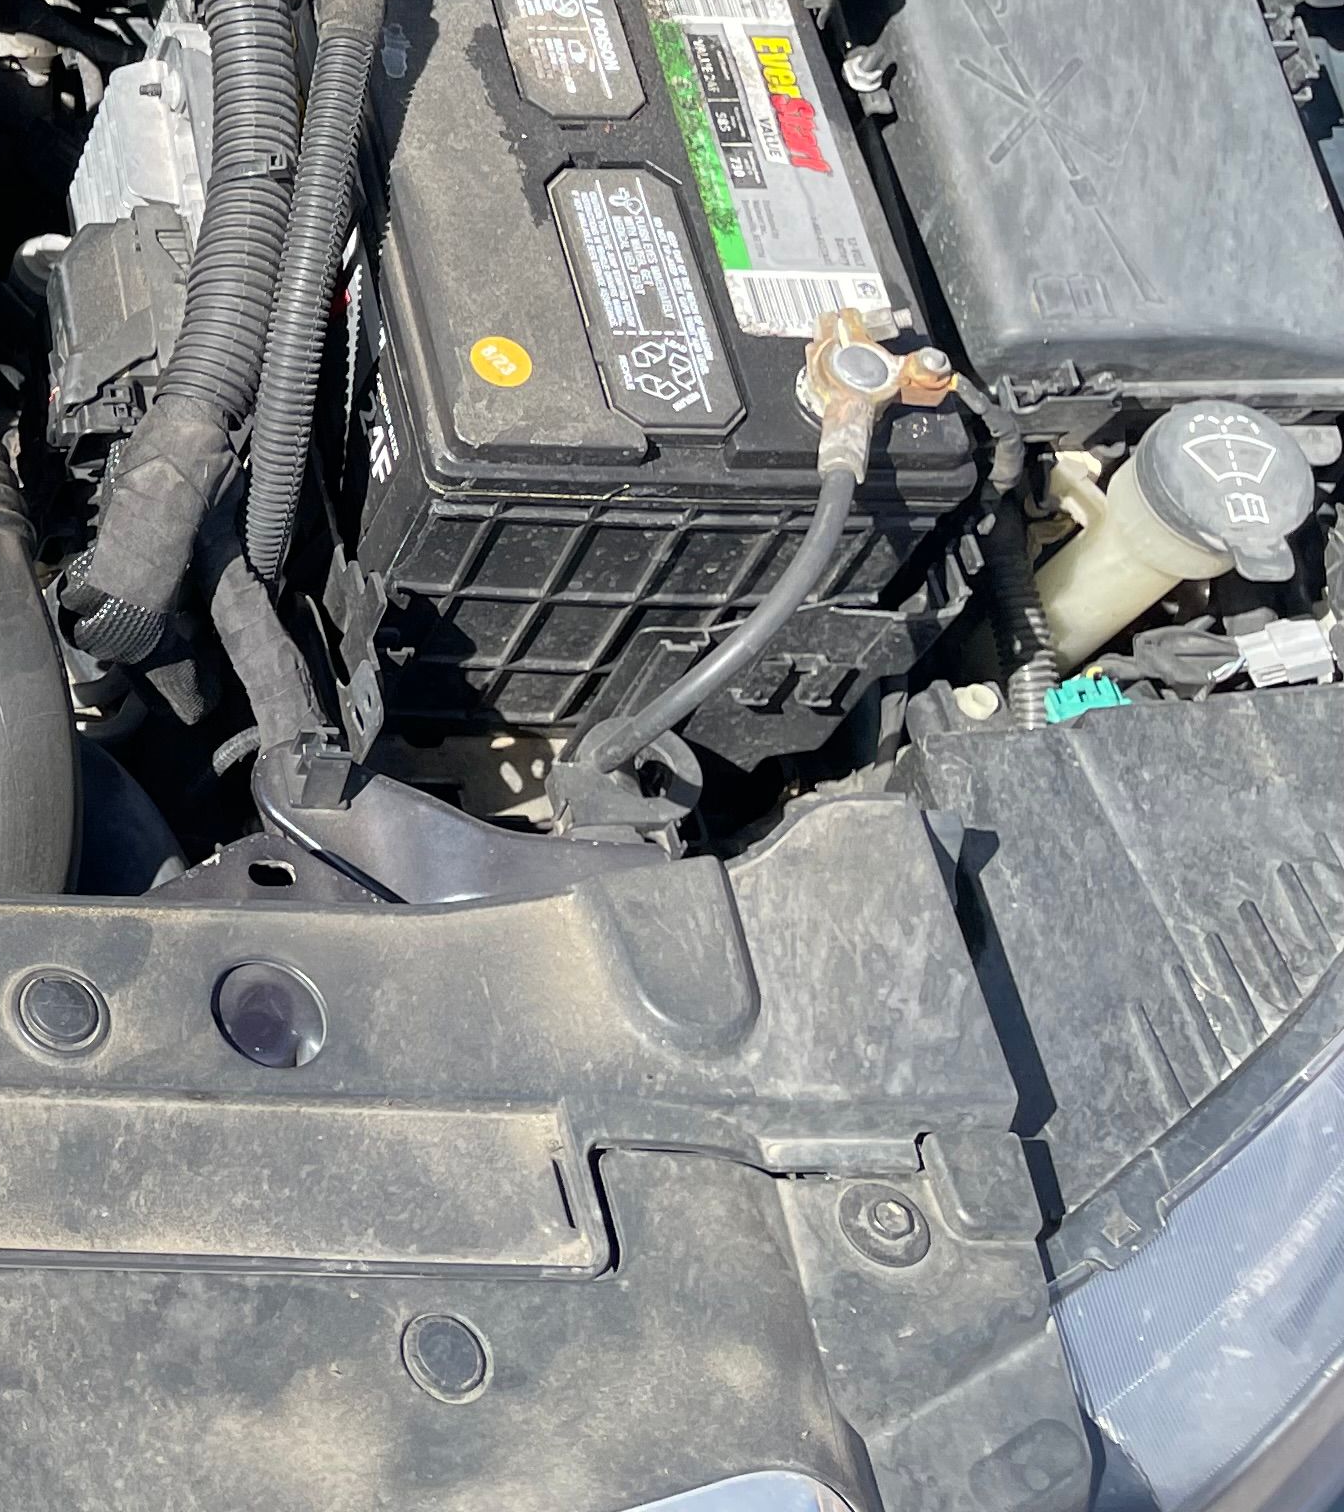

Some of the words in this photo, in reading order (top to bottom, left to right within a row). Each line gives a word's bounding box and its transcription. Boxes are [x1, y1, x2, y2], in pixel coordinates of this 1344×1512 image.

[589, 18, 620, 71] POISON
[757, 118, 782, 157] VALUE
[633, 216, 651, 243] FLUSH
[622, 251, 638, 273] HELP
[641, 242, 657, 264] EYES
[629, 273, 645, 296] FAST
[480, 344, 518, 376] 8/23
